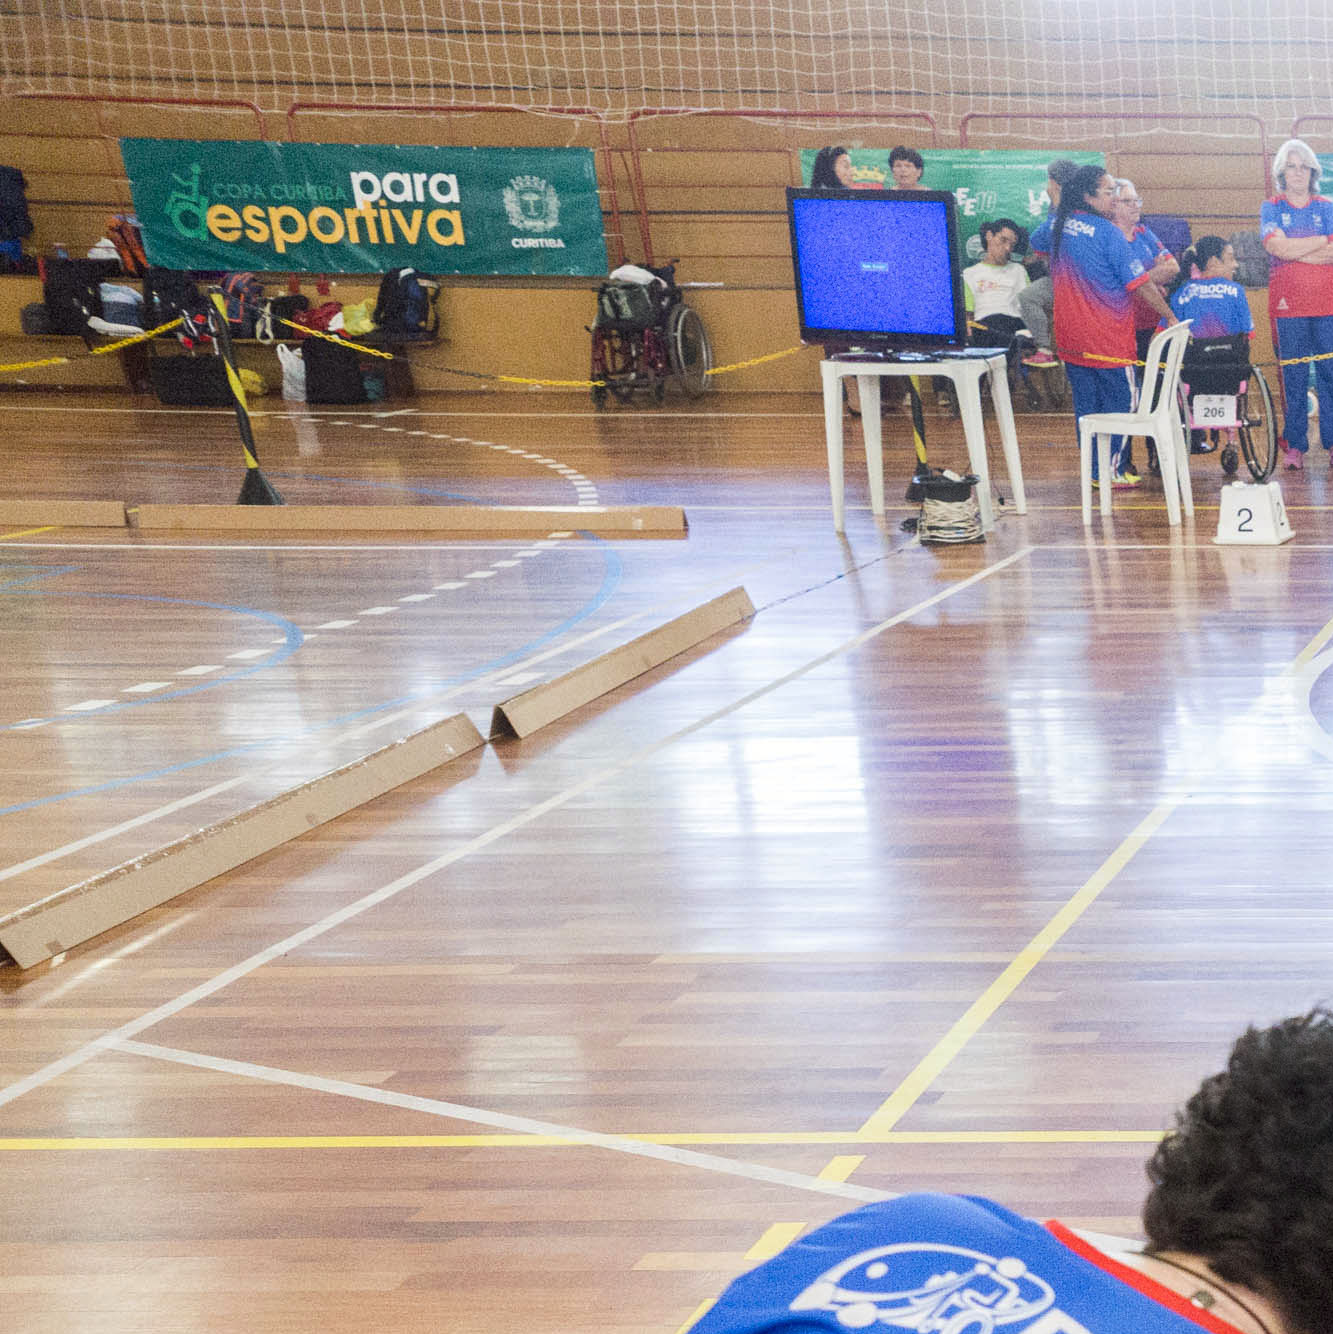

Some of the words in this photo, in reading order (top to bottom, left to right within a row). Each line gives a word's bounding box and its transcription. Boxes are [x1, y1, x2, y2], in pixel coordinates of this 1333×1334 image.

[212, 182, 265, 200] COPA
[270, 183, 347, 201] CURITIBA
[349, 171, 460, 210] para
[511, 237, 565, 249] CURITIBA
[1199, 283, 1238, 298] BOCHA
[1203, 407, 1226, 418] 206
[1237, 507, 1254, 533] 2
